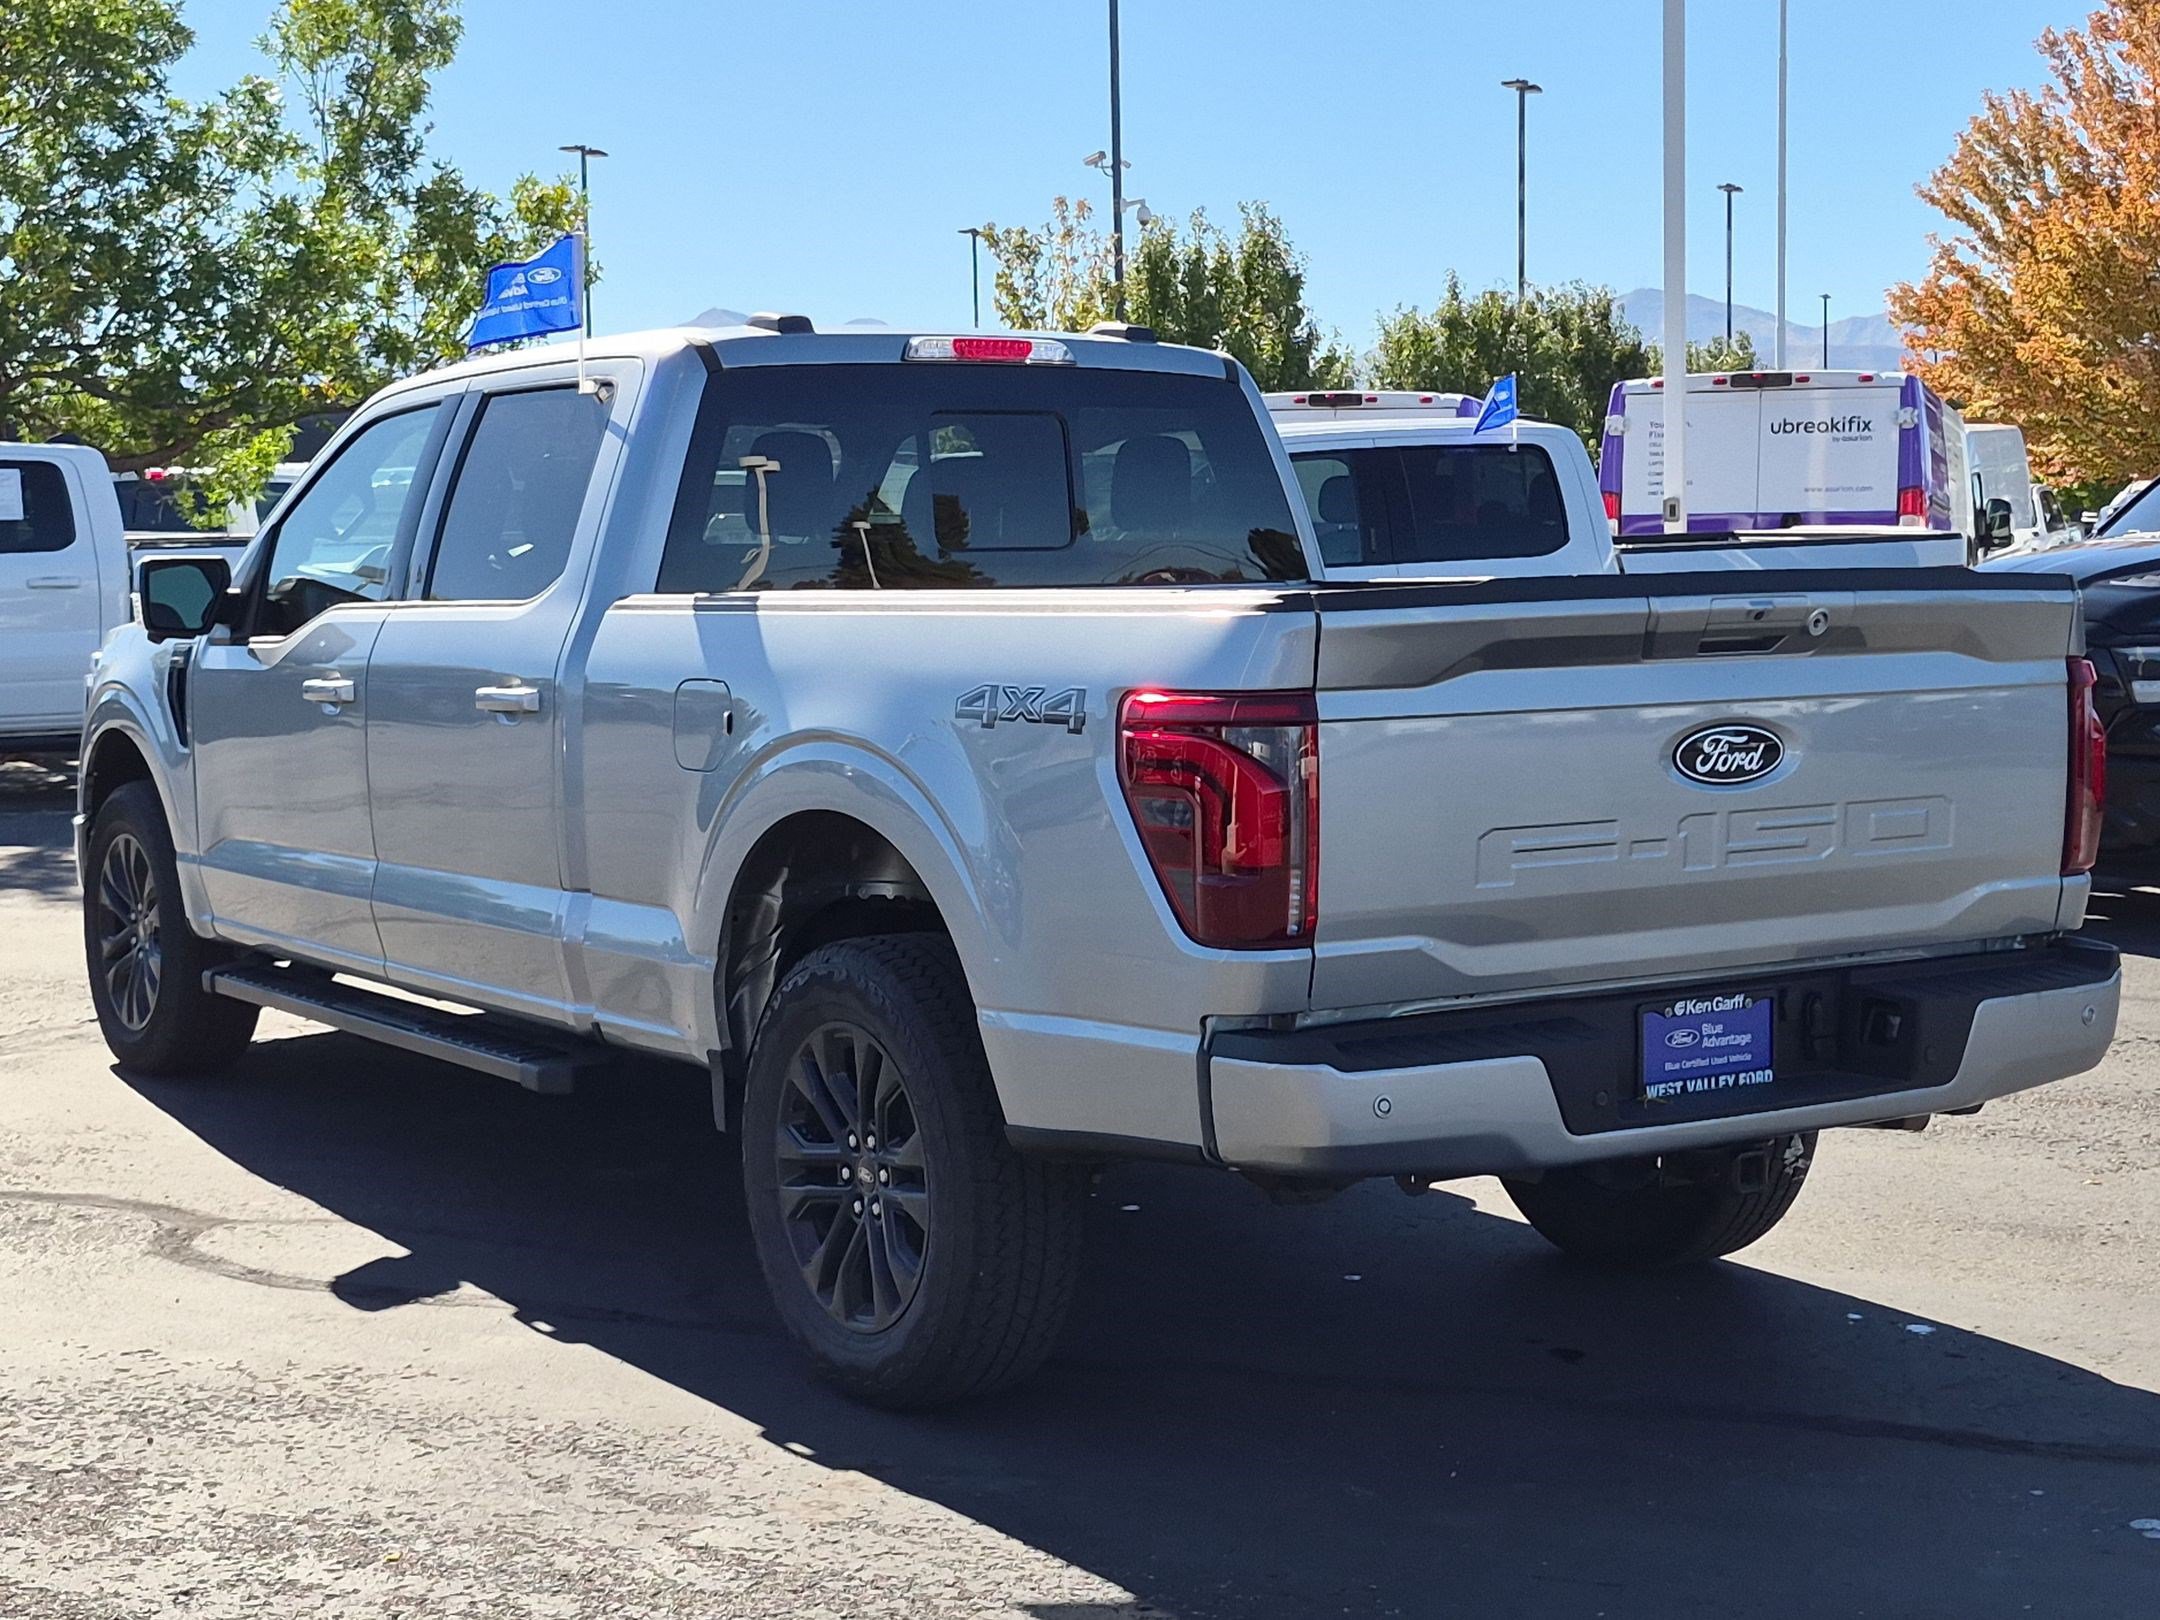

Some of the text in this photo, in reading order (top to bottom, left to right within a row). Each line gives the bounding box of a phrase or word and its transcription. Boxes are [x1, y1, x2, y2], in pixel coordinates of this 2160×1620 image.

[1770, 416, 1872, 434] ubreakifix
[1696, 734, 1765, 774] Ford
[1476, 794, 1954, 889] F-150
[1702, 1023, 1724, 1035] Blue
[1671, 1032, 1694, 1045] Ford
[1702, 1033, 1752, 1049] Advantage
[1664, 1053, 1752, 1071] Blue Certified Used Vehicle
[1646, 1069, 1774, 1099] WEST VALLEY FORD
